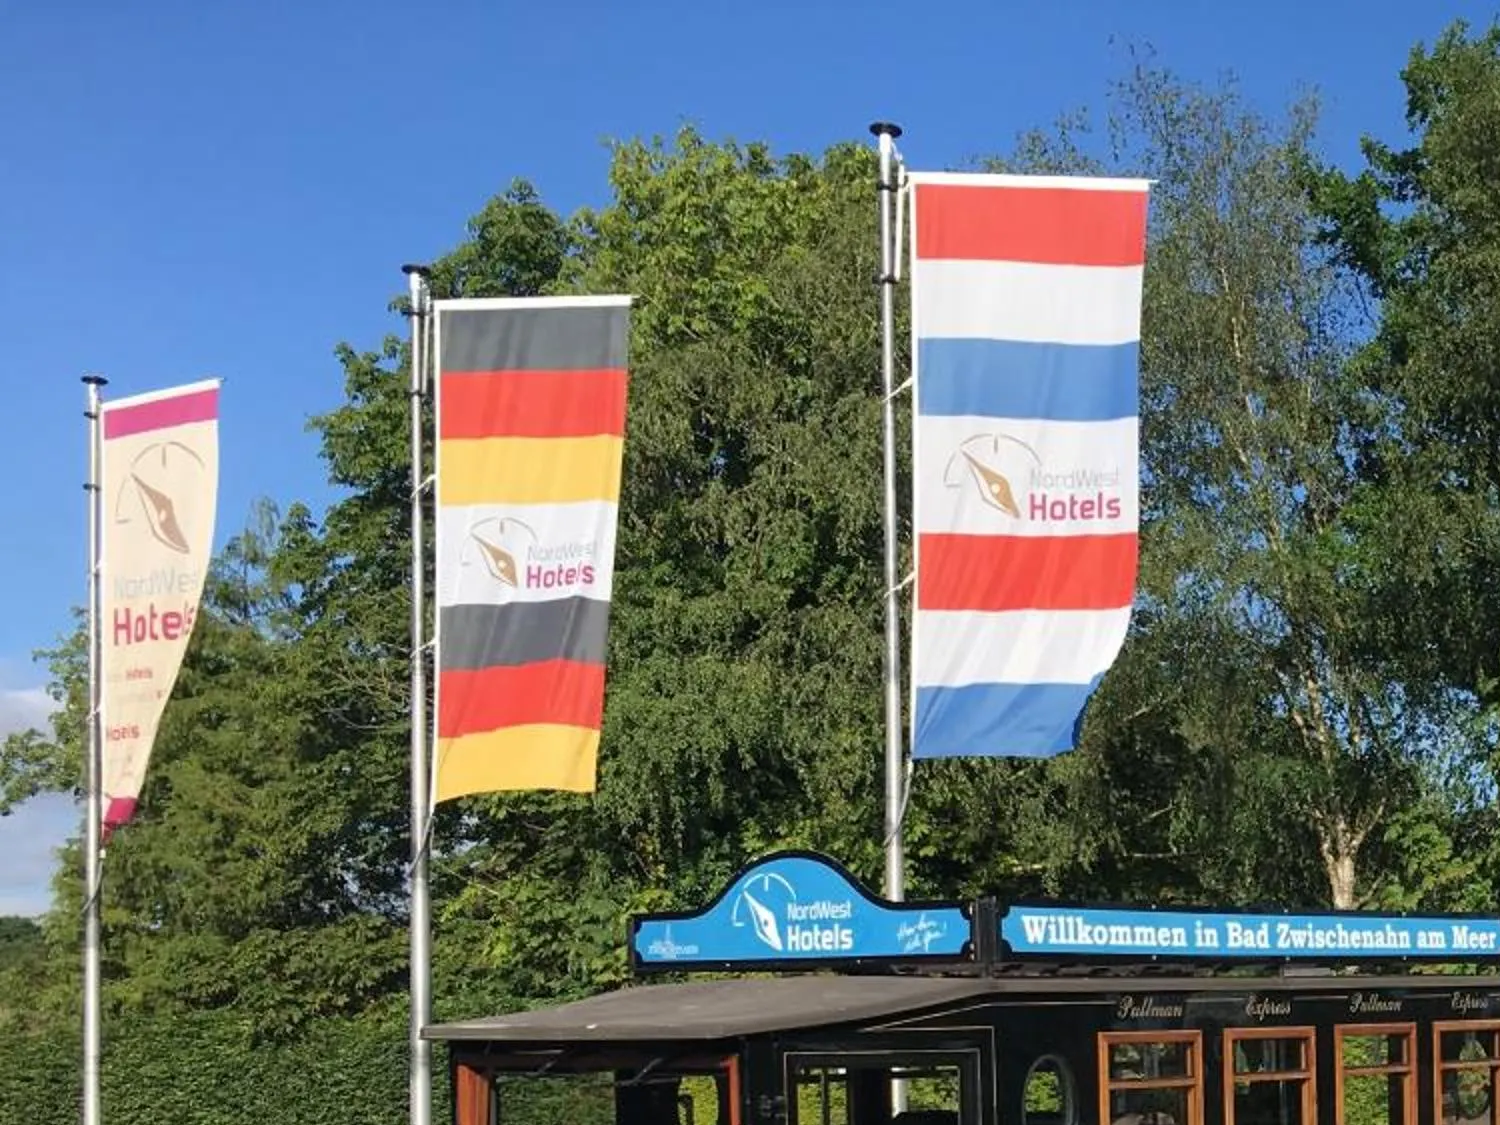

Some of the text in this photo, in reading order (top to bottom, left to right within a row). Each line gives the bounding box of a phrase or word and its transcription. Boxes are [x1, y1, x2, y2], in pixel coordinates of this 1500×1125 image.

[1031, 466, 1119, 489] NordWest
[1030, 492, 1121, 520] Hotels
[526, 560, 595, 589] Hotels
[113, 600, 195, 646] Hotels
[787, 900, 851, 920] NordWest
[787, 922, 853, 952] Hotels
[1021, 914, 1498, 950] Willkommen in Bad Zwischenahn am Meer
[1117, 995, 1183, 1018] Pullman
[1245, 993, 1291, 1021] Express
[1350, 991, 1403, 1014] Pullman
